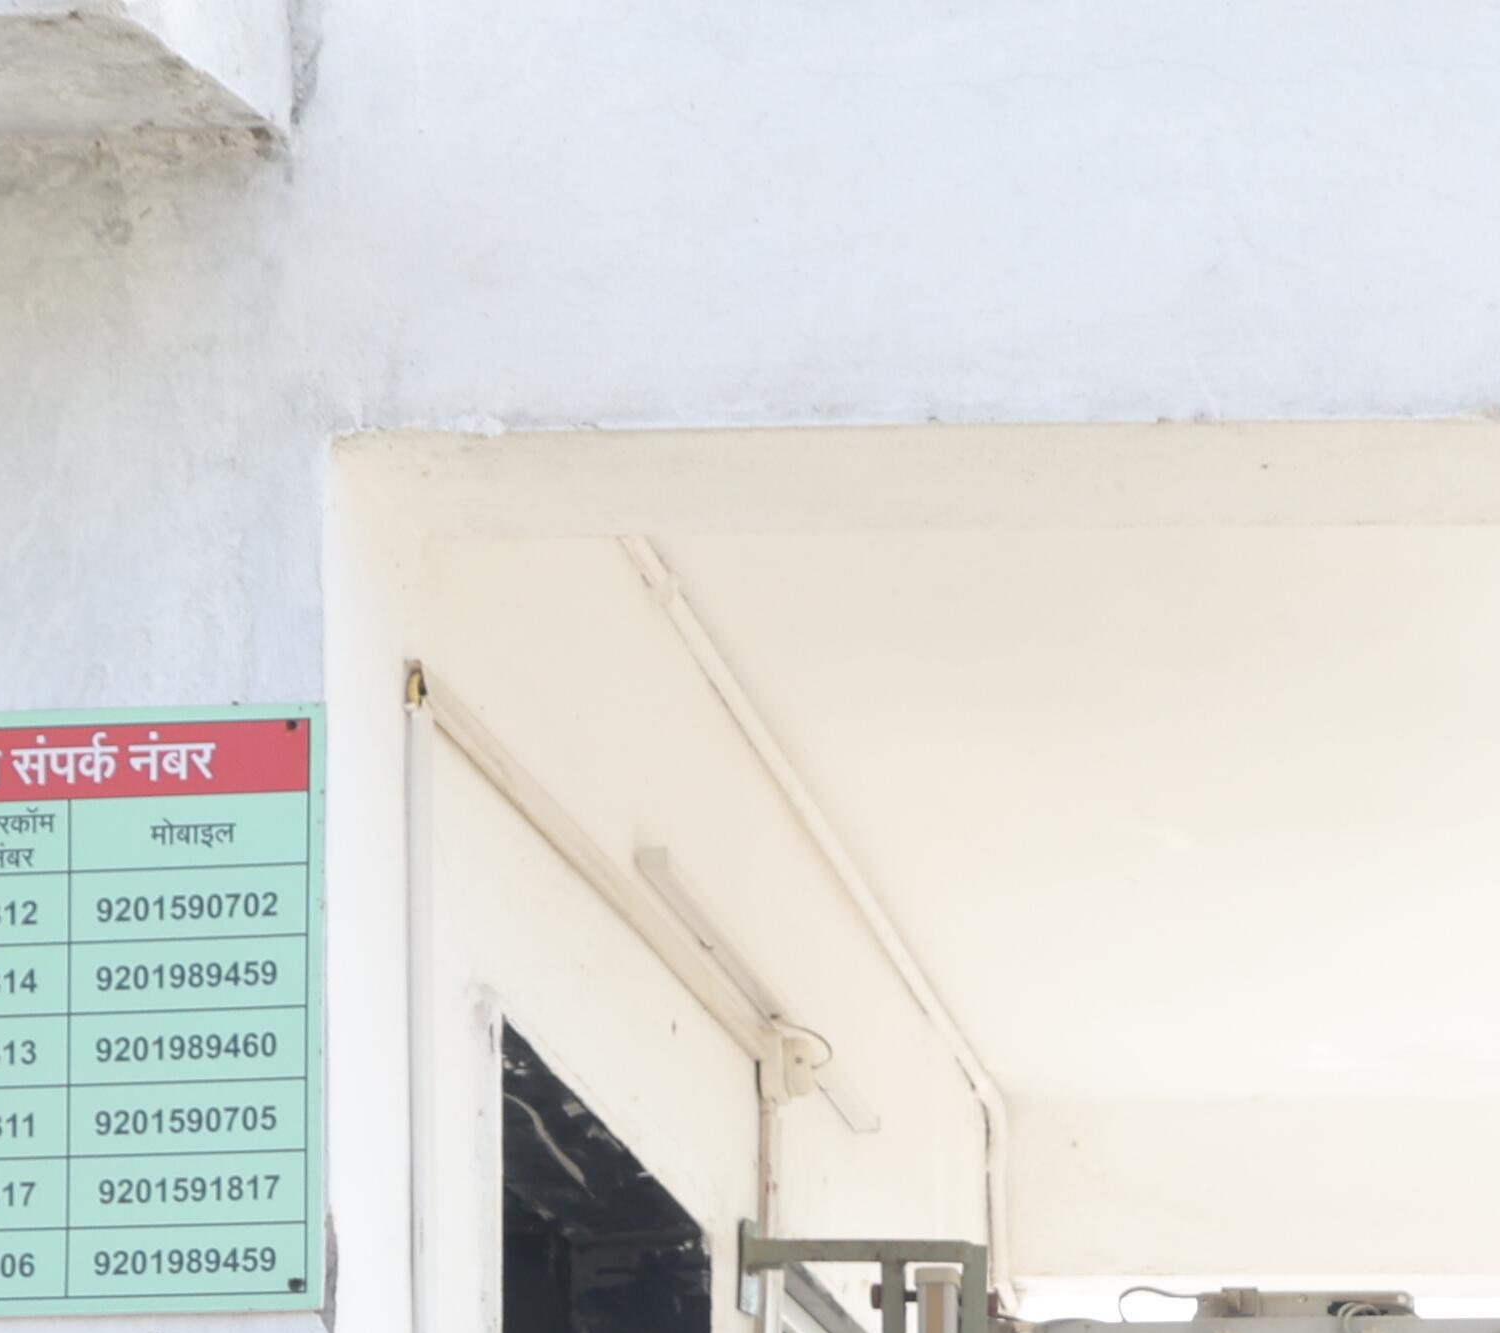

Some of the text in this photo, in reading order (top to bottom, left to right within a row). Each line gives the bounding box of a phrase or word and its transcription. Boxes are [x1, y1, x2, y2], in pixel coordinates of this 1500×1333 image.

[10, 734, 119, 786] संपर्क
[127, 730, 217, 782] नंबर
[149, 817, 237, 849] मोबाइल
[96, 891, 278, 923] 9201590702
[95, 959, 278, 992] 9201989459
[95, 1031, 278, 1063] 9201989460
[94, 1105, 277, 1137] 9201590705
[98, 1174, 281, 1205] 9201591817
[93, 1246, 277, 1277] 9201989459
